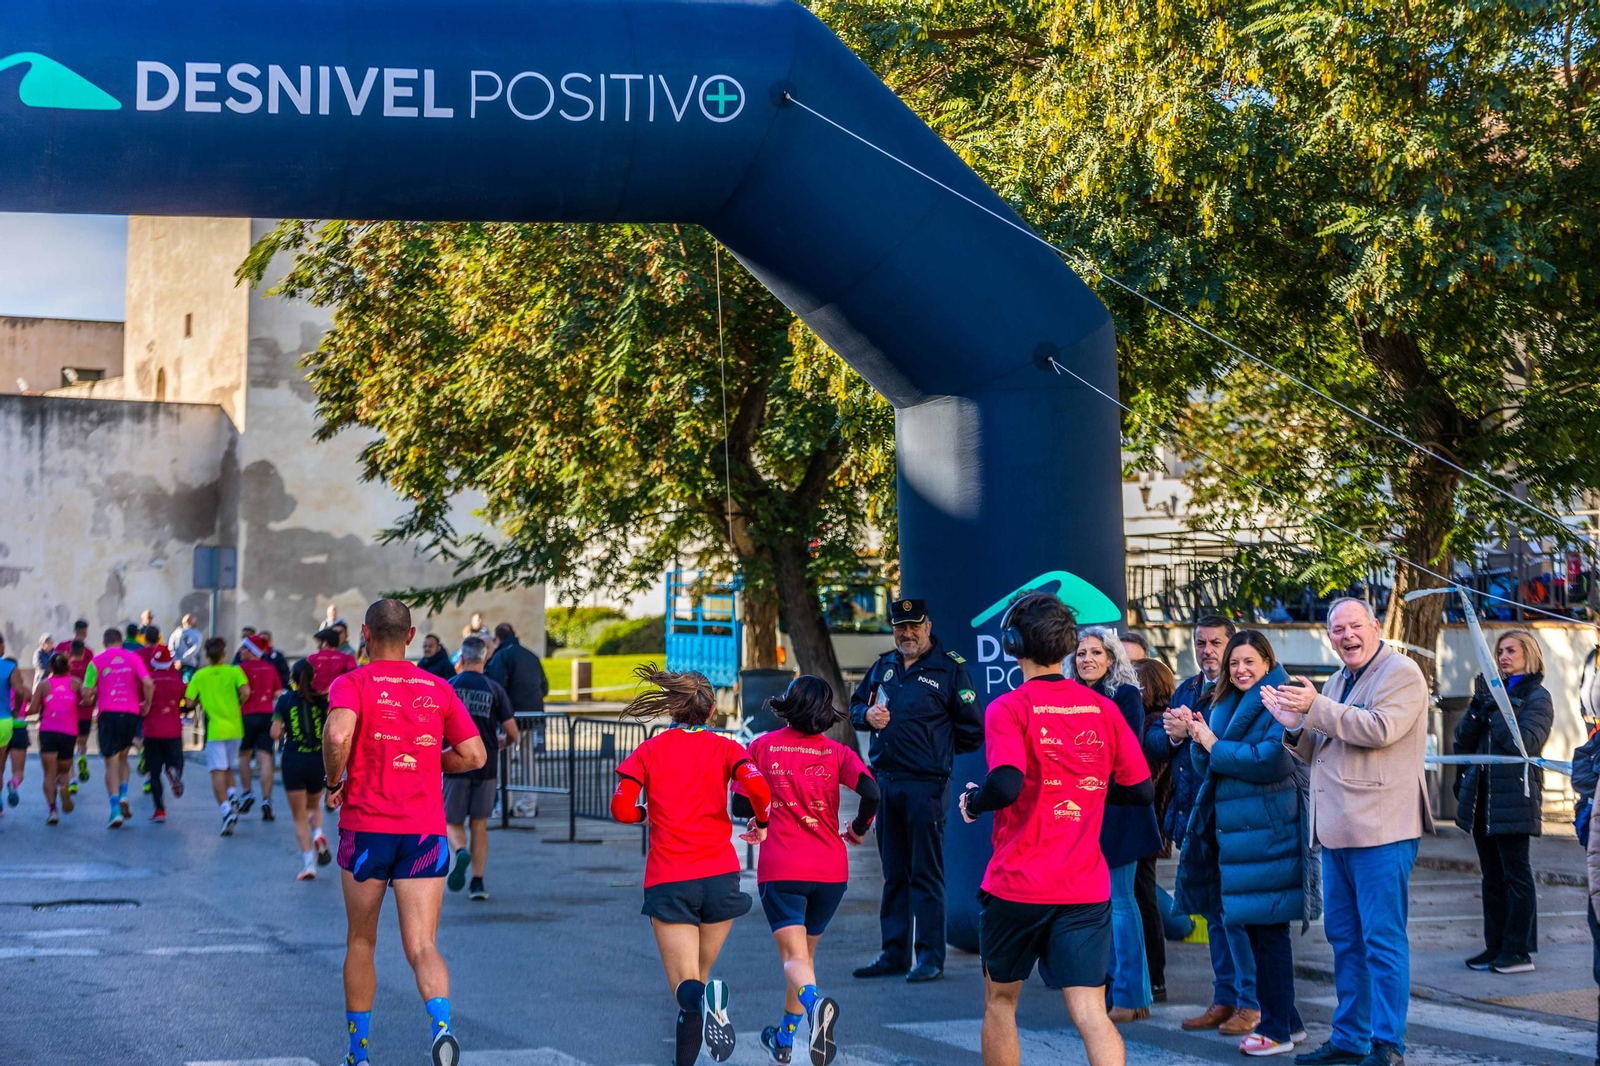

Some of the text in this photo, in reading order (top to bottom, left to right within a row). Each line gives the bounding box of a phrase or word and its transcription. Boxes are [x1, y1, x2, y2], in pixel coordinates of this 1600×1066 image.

[136, 60, 746, 123] DESNIVEL POSITIVO
[917, 675, 939, 689] POLICIA
[377, 698, 402, 708] MARISCAL
[1053, 809, 1082, 817] DESNIVEL
